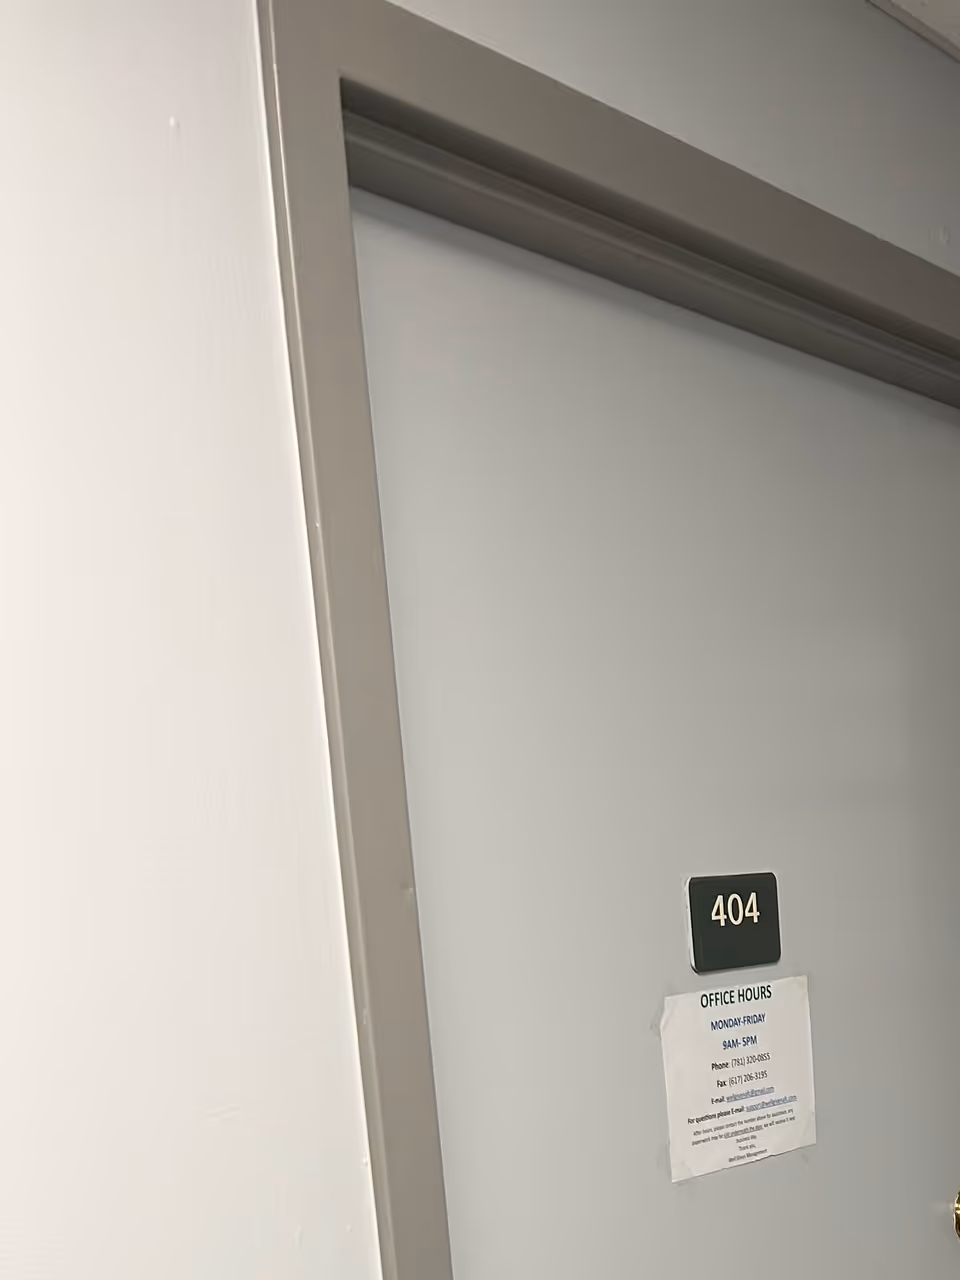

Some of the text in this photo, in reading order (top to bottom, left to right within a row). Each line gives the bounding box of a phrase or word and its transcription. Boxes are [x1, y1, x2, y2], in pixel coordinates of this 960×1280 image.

[711, 892, 760, 927] 404
[700, 985, 772, 1008] OFFICE HOURS
[711, 1013, 766, 1031] MONDAY-FRIDAY
[742, 1036, 758, 1047] 5PM
[711, 1061, 730, 1071] Phone:
